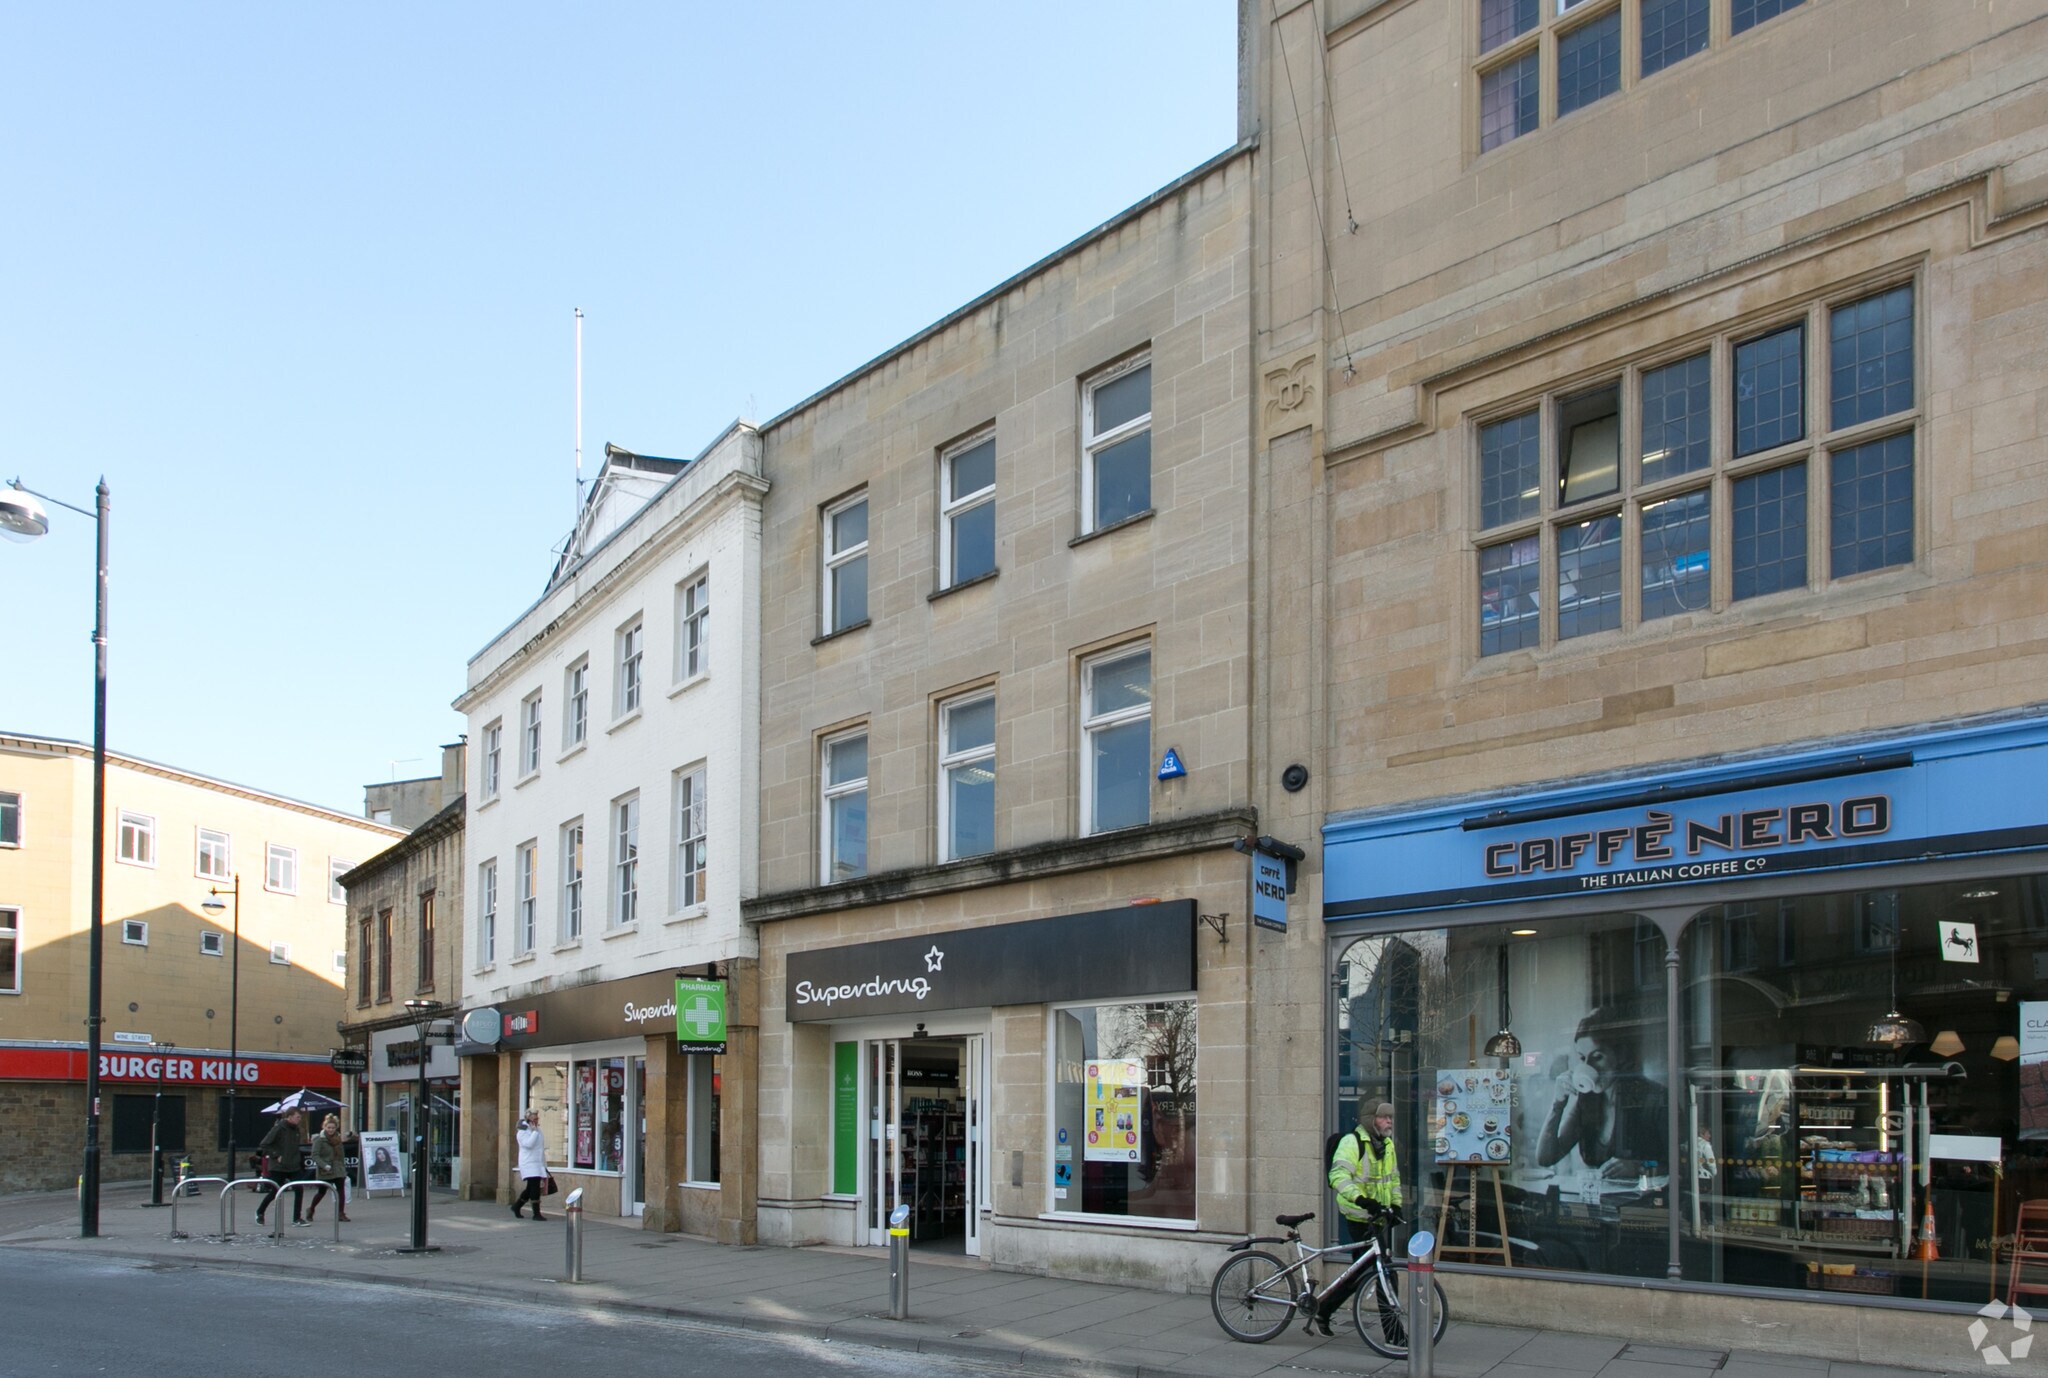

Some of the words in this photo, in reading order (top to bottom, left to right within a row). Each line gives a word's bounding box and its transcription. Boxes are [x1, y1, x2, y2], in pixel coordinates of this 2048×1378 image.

[1485, 810, 1673, 877] CAFFÈ
[1687, 794, 1890, 856] NERO
[1580, 873, 1608, 888] THE
[1612, 867, 1673, 885] ITALIAN
[1677, 860, 1739, 878] COFFEE
[1256, 880, 1285, 901] NERO
[681, 982, 721, 992] PHARMACY
[795, 975, 931, 1007] Superdrug
[682, 1044, 722, 1053] Superdrug
[99, 1055, 195, 1080] BURGER
[201, 1060, 259, 1082] KING
[333, 1059, 366, 1067] ORCHARD
[1975, 1237, 2036, 1252] MOCHA
